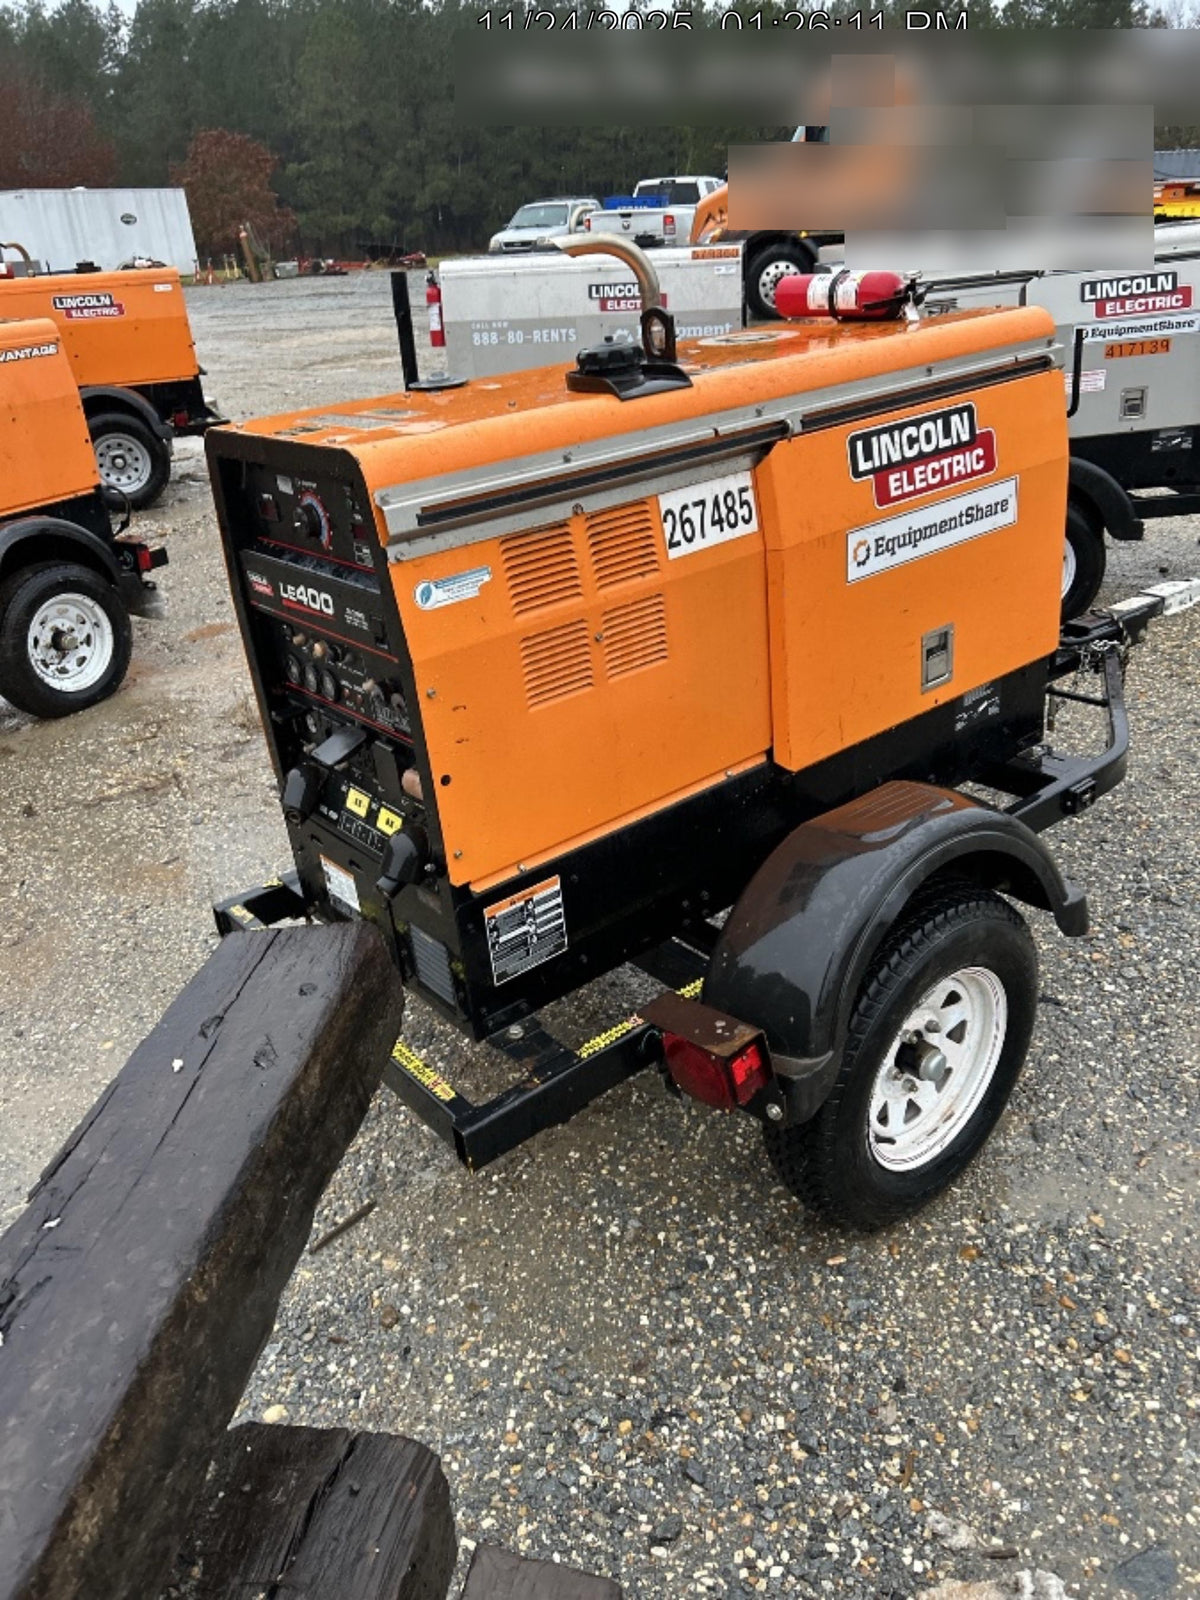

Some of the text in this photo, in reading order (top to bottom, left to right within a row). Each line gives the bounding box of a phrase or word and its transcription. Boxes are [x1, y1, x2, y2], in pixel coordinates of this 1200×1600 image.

[592, 284, 641, 298] LINCOL
[1084, 274, 1173, 301] LINCOLN
[54, 295, 111, 309] LINCOLN
[71, 306, 120, 317] ELECTRIC
[607, 300, 642, 310] ELECT
[1105, 294, 1184, 315] ELECTRIC
[472, 328, 577, 346] 888-80-RENTS
[1091, 319, 1195, 338] EquipmentShare
[1105, 339, 1170, 358] 417139
[855, 411, 971, 472] LINCOLN
[888, 448, 985, 498] ELECTRIC
[662, 485, 752, 550] 267485
[874, 498, 1010, 557] EquipmentShare
[279, 582, 335, 616] LE400
